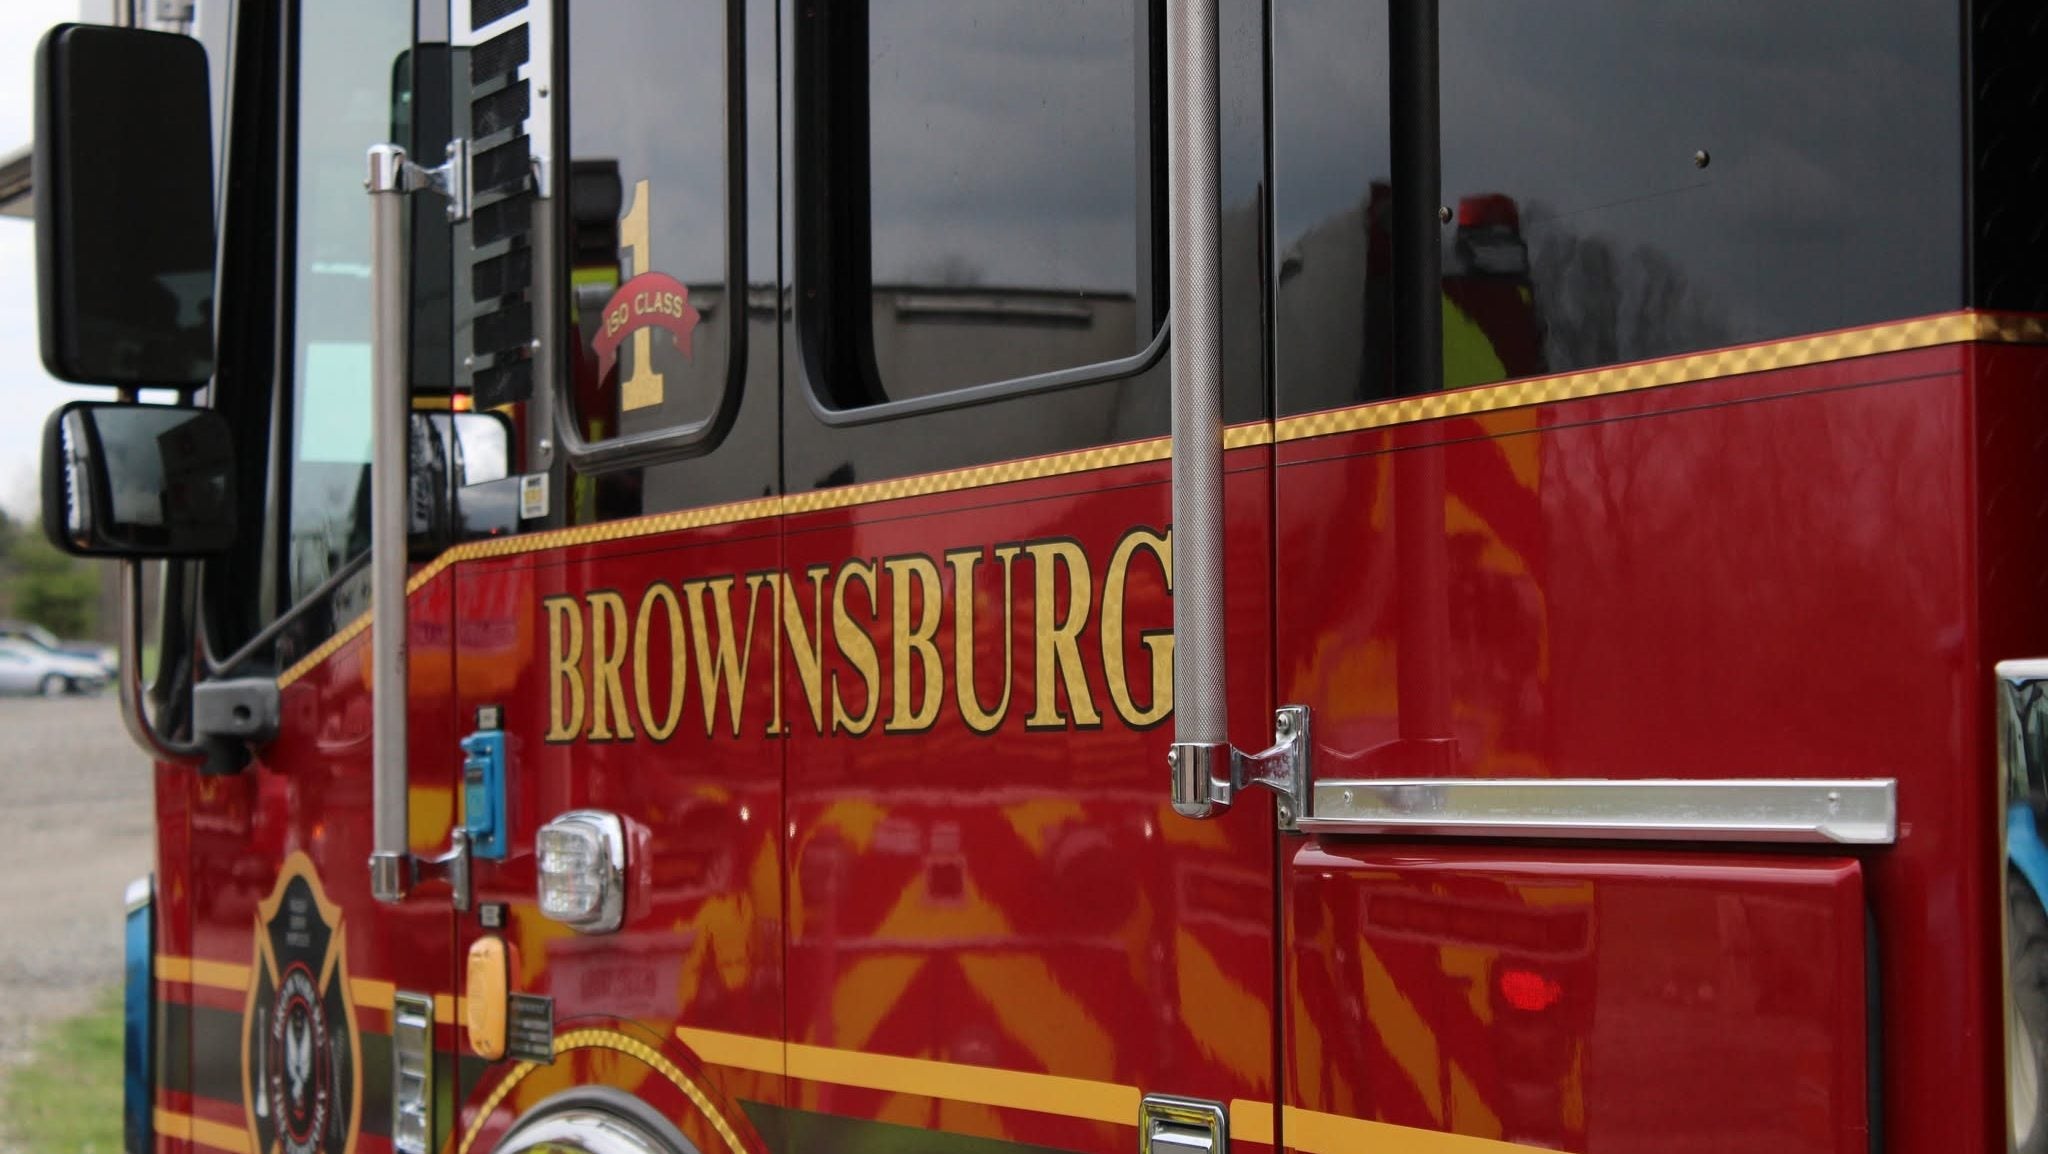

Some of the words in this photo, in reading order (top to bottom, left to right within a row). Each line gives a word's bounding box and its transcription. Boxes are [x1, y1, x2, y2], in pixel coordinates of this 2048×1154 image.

[607, 303, 629, 338] ISO
[634, 291, 683, 319] CLASS
[620, 179, 664, 412] 1
[543, 526, 1174, 744] BROWNSBURG
